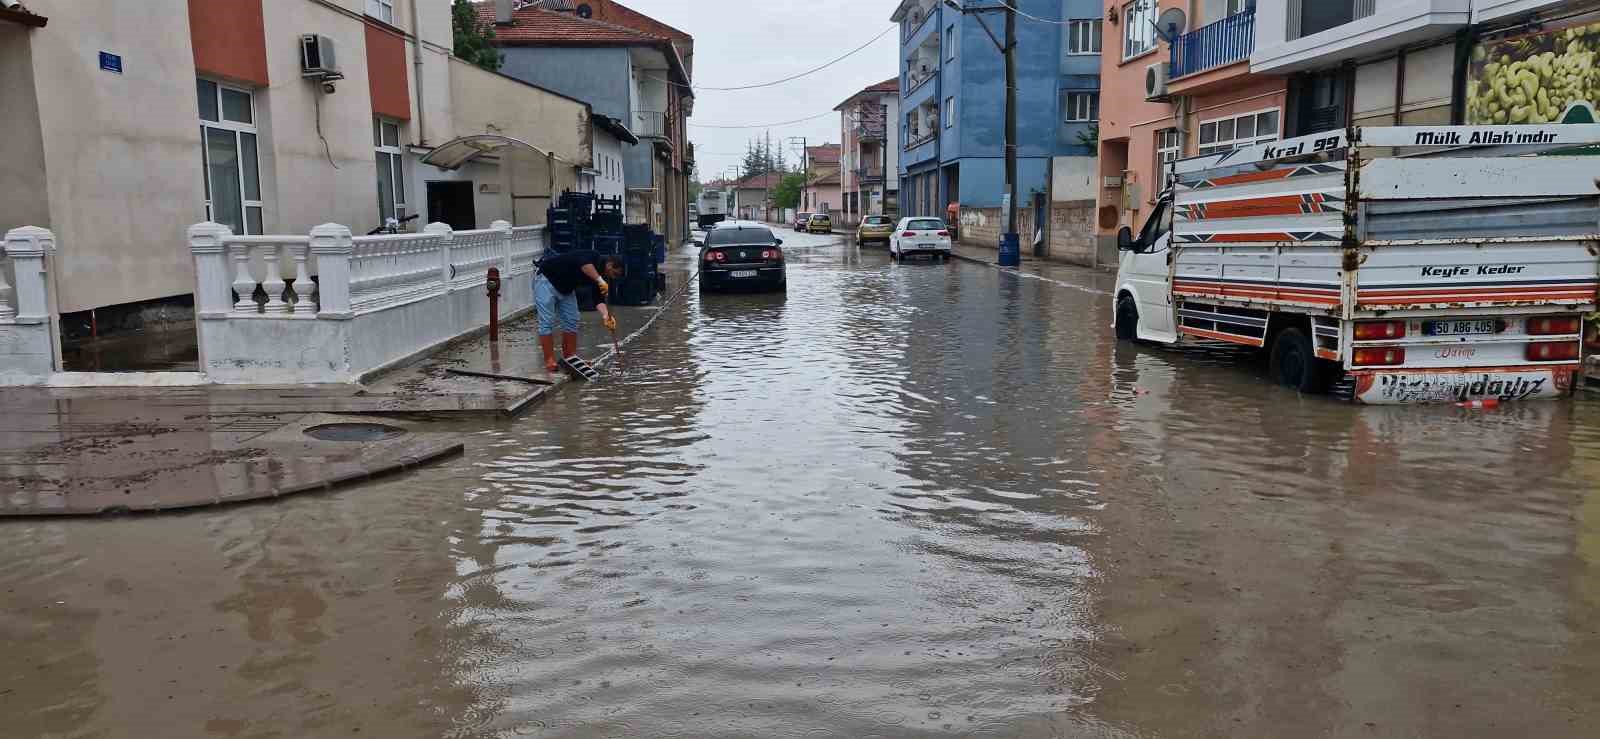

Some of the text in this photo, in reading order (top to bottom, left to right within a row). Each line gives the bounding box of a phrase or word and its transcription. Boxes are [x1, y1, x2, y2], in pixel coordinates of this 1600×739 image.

[1415, 128, 1558, 145] Mülk Allah'ındır
[1263, 136, 1340, 160] Kral 99
[1421, 264, 1526, 278] Keyfe Keder
